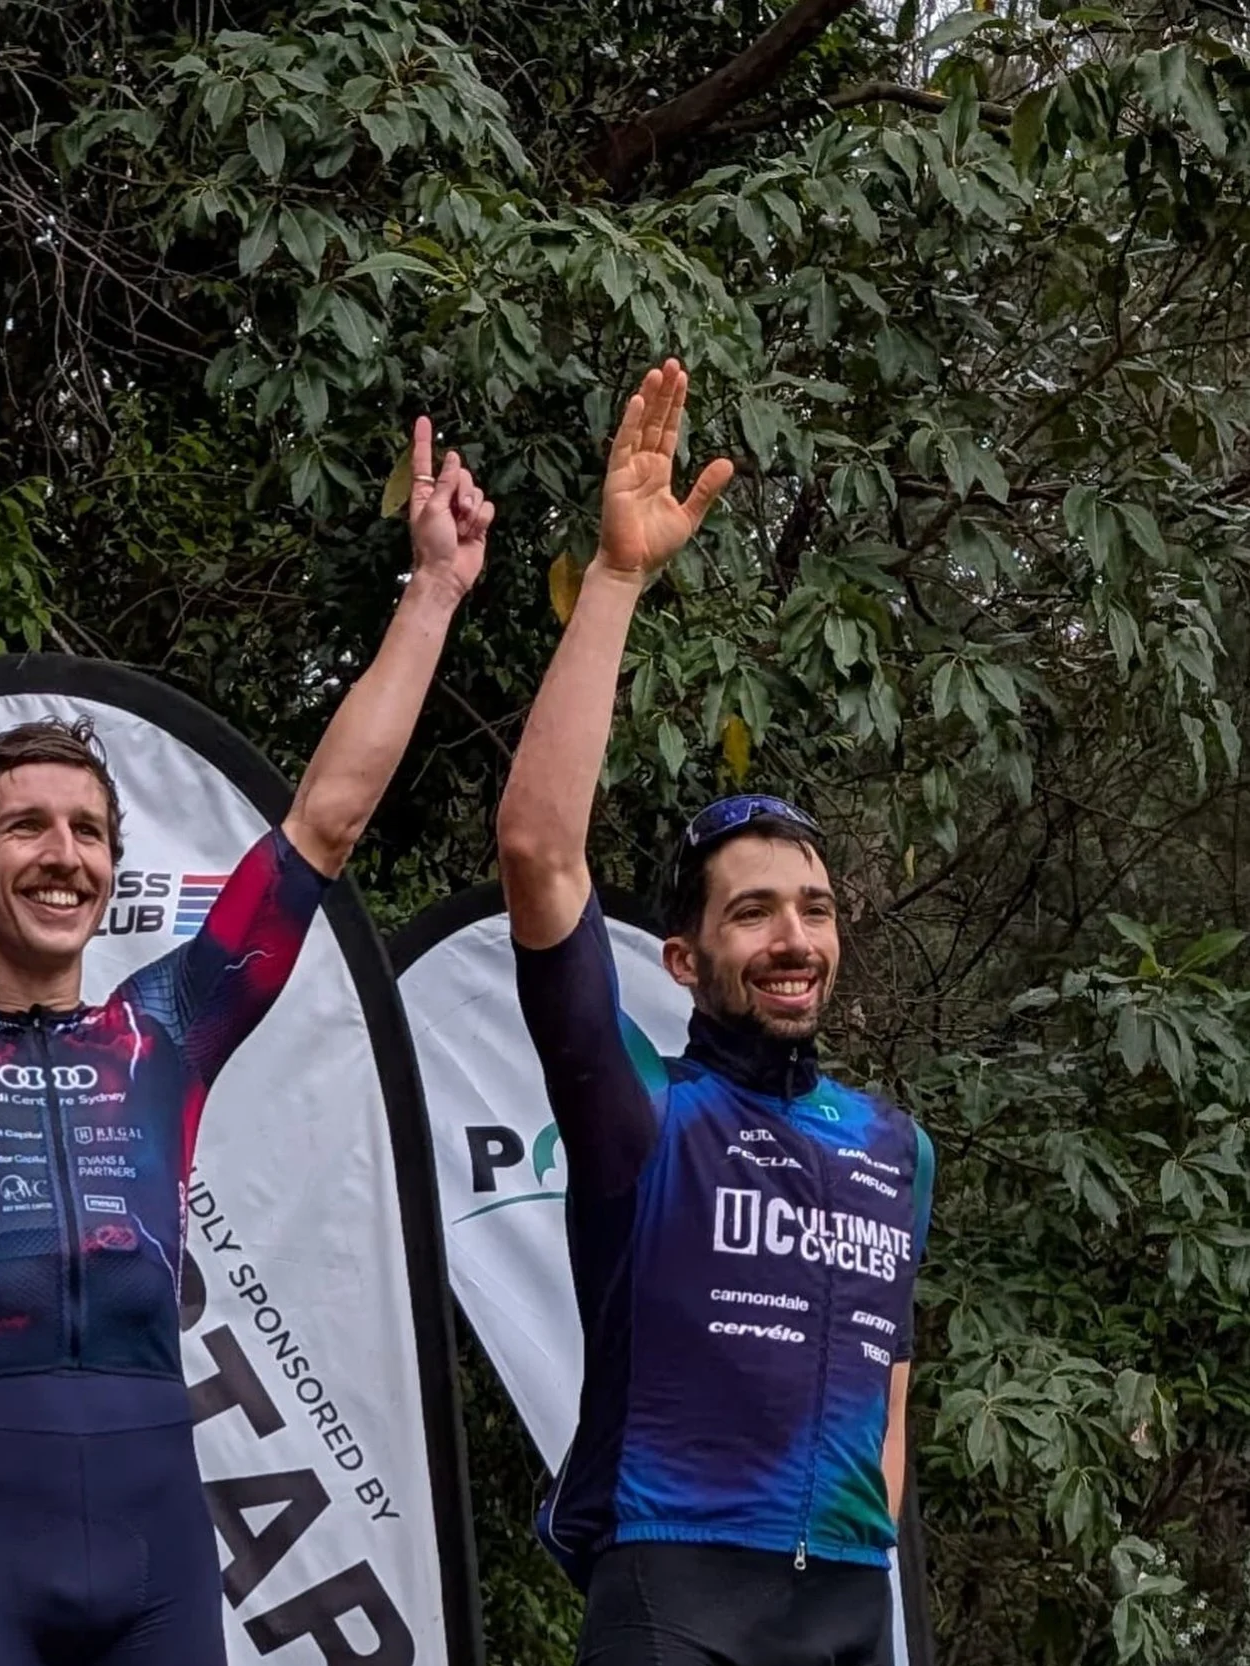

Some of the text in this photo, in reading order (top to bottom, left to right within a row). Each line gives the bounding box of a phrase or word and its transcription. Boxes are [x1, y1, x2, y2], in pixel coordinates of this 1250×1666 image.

[78, 1092, 126, 1106] Sydney
[77, 1155, 116, 1166] EVANS
[78, 1166, 137, 1178] PARTNERS
[796, 1206, 912, 1262] ULTIMATE
[801, 1229, 897, 1283] CYCLES
[710, 1288, 810, 1312] cannondale
[708, 1321, 806, 1343] cervélo
[852, 1310, 897, 1336] GIANT
[227, 1262, 364, 1474] SPONSORED
[354, 1478, 400, 1525] BY
